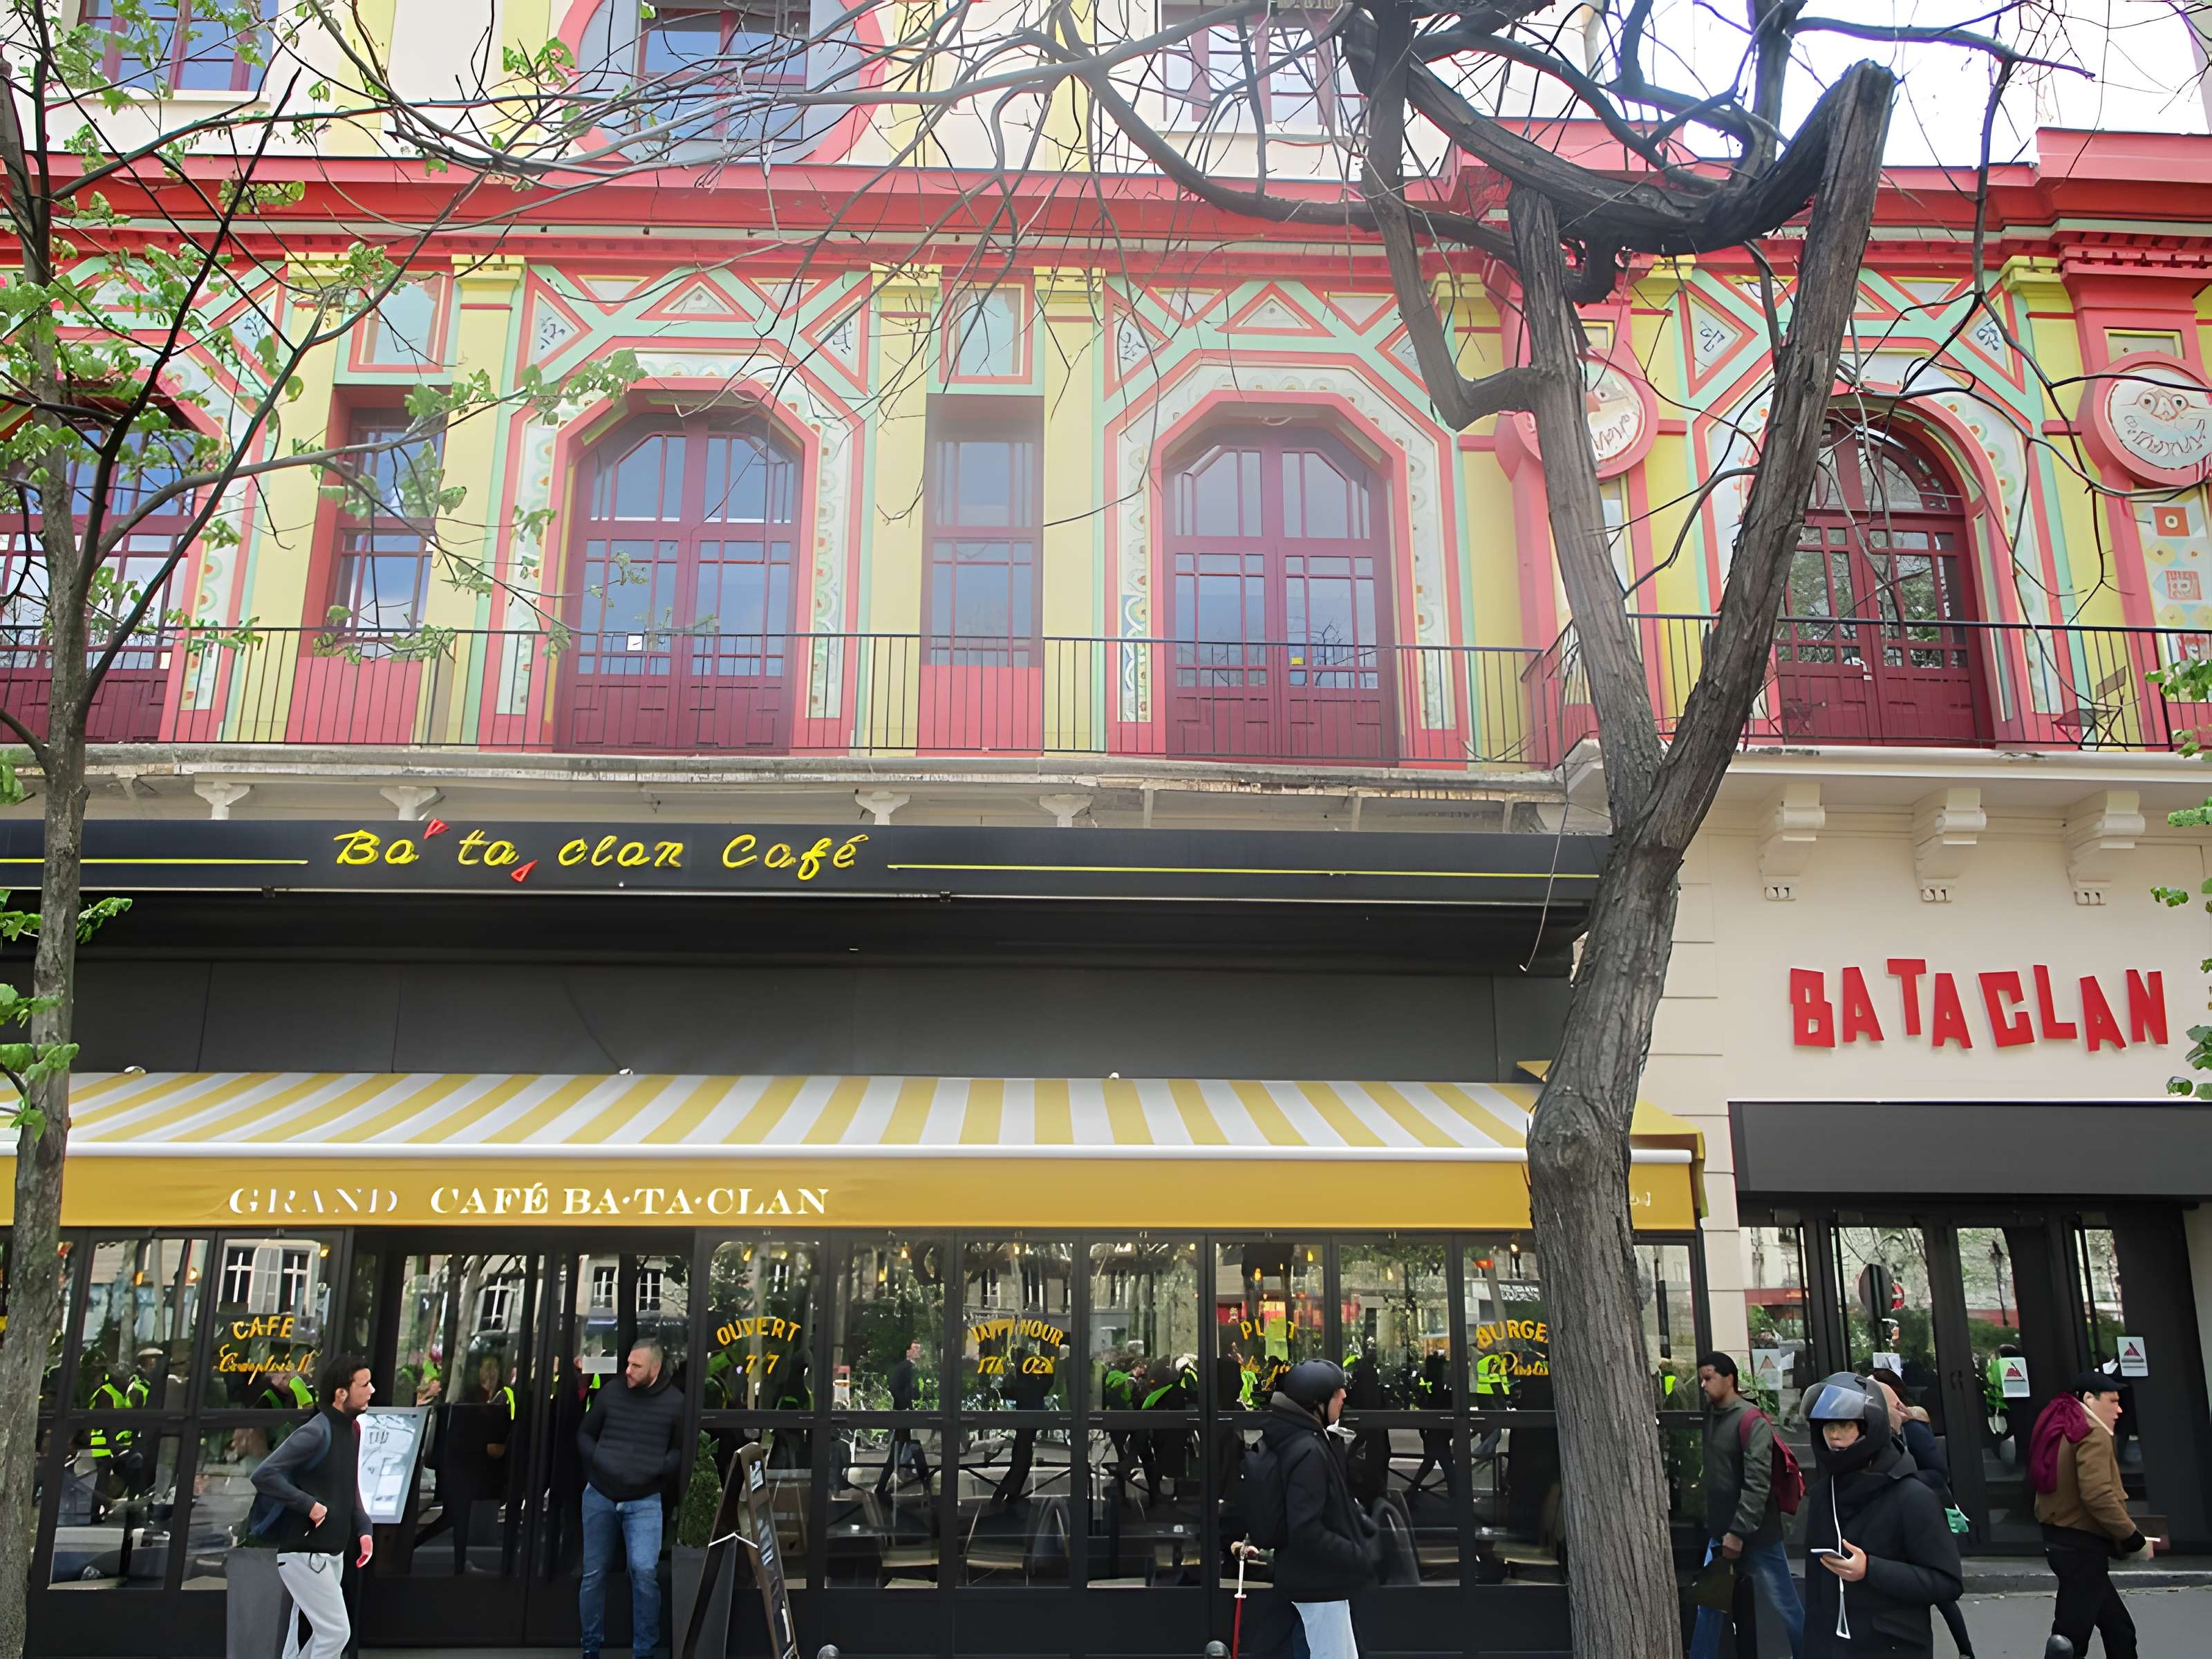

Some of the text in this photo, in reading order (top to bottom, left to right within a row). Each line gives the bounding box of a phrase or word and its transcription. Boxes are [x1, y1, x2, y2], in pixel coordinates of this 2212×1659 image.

[722, 834, 869, 881] Café
[1789, 957, 2169, 1052] BATACLAN
[229, 1188, 399, 1214] GRAND
[431, 1181, 549, 1214] CAFÉ
[716, 1316, 802, 1346] OUVERT
[1475, 1319, 1549, 1349] BURGE
